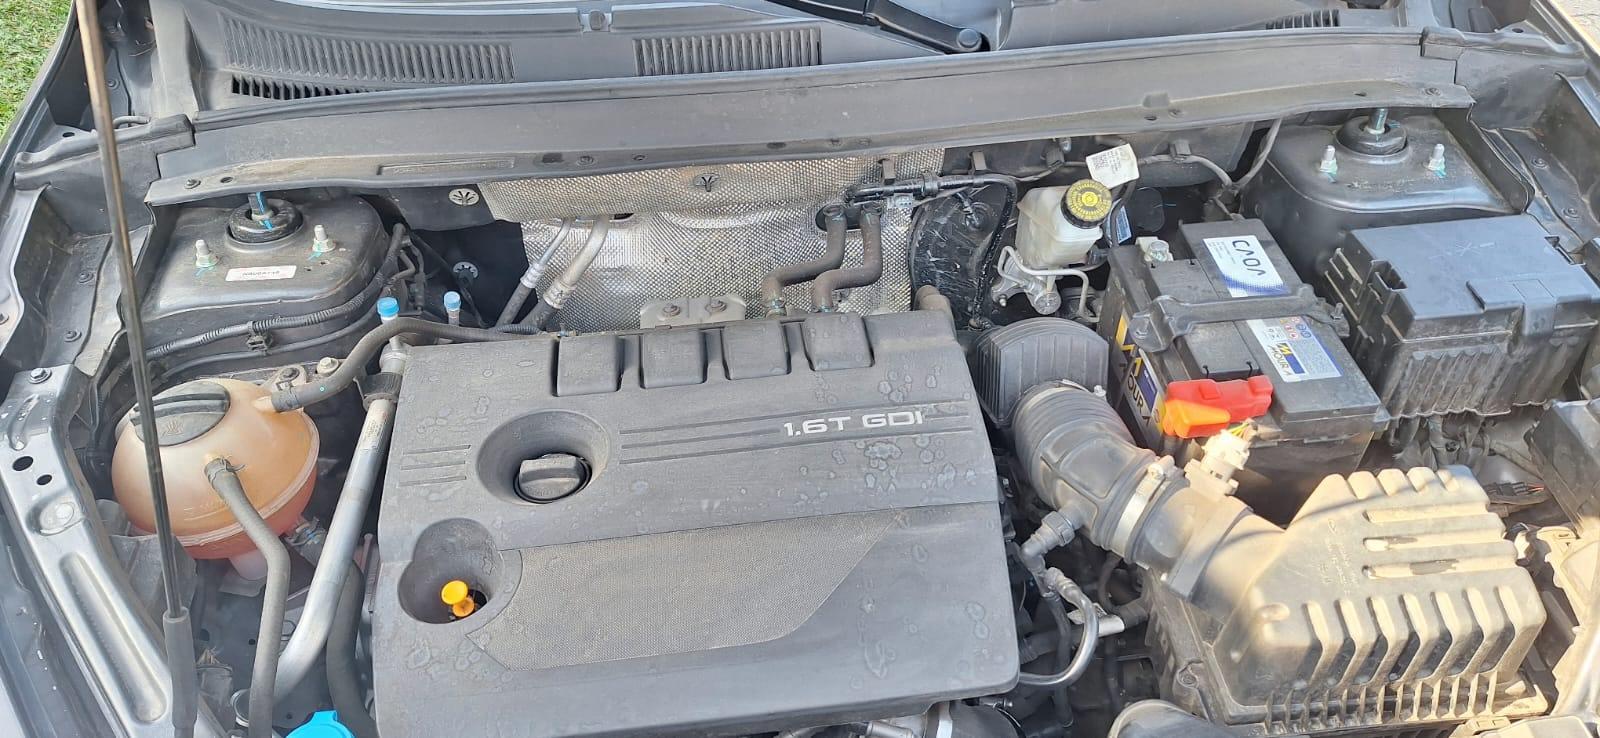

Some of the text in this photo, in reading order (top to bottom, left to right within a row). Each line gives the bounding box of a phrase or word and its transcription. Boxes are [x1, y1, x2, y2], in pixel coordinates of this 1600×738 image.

[1267, 344, 1293, 376] MOURA
[1123, 367, 1151, 427] OURA
[784, 411, 923, 436] 1.6T GDI
